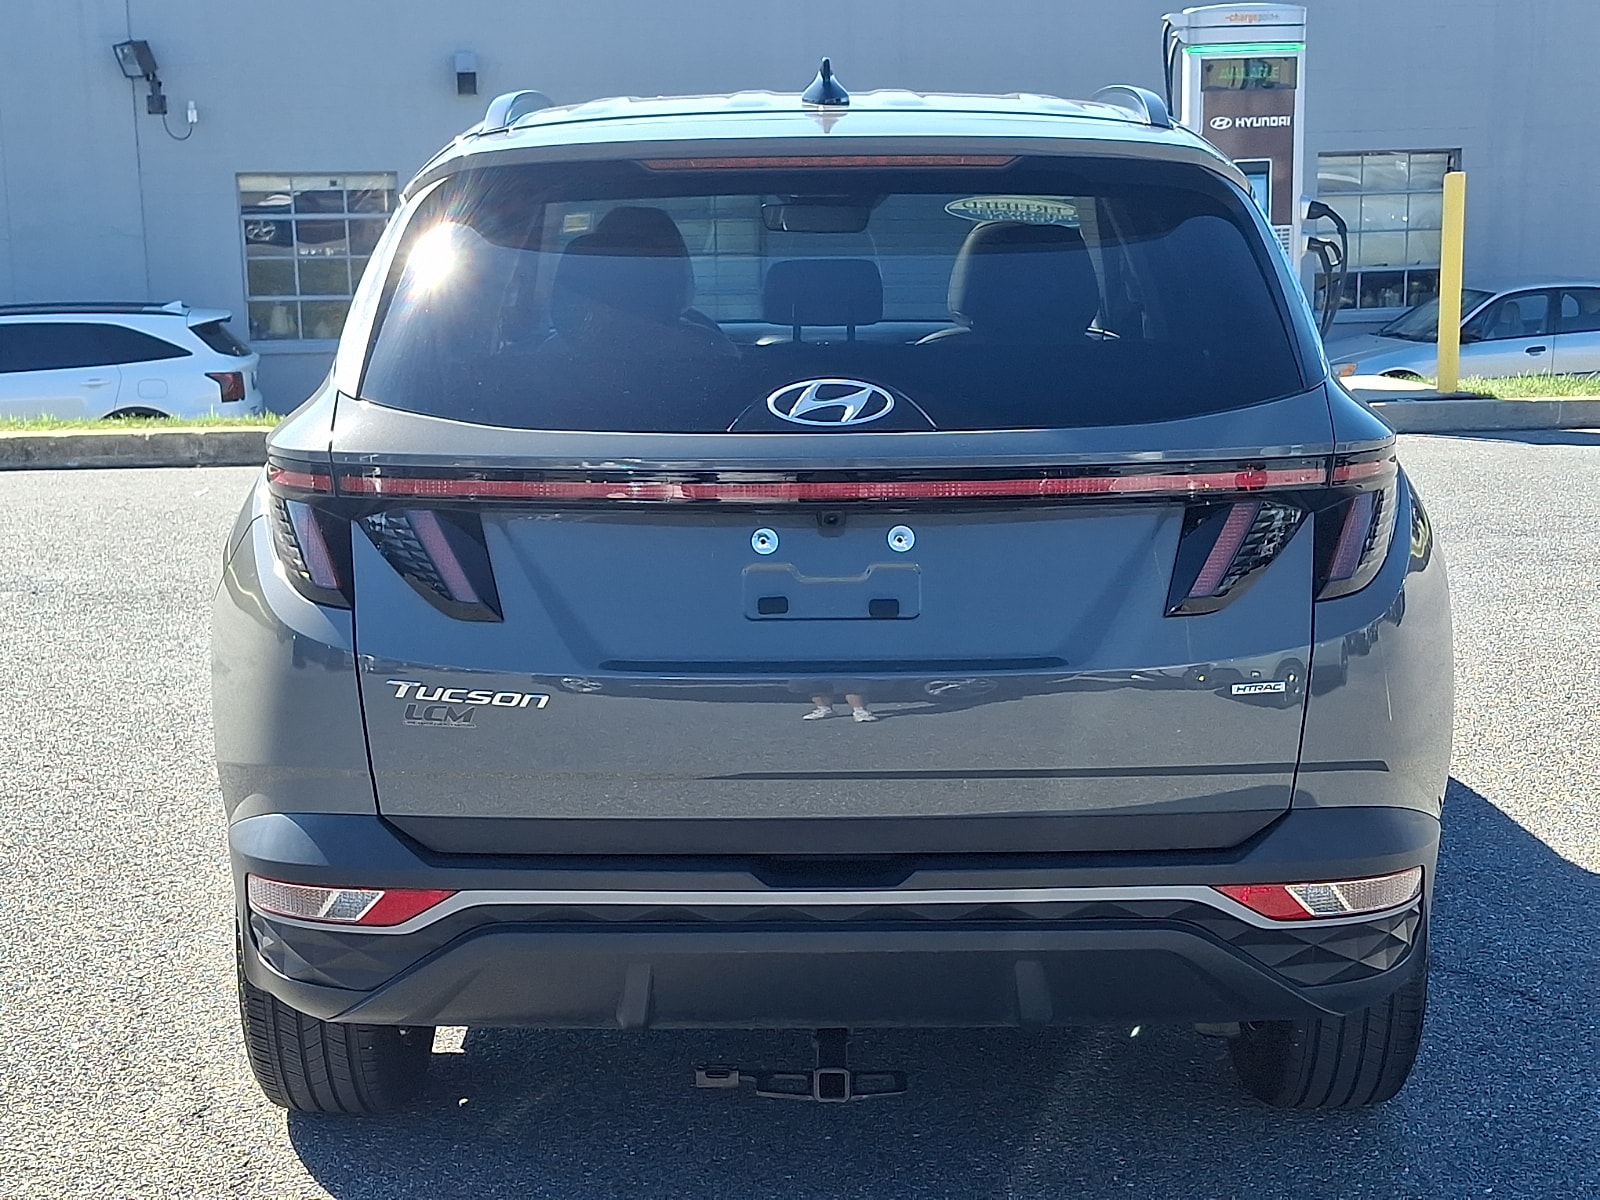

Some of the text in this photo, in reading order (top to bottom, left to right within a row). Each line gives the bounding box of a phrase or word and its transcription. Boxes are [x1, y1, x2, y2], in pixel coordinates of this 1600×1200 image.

[1235, 116, 1291, 127] HYUNDAI
[1236, 684, 1282, 692] HTRAC
[404, 703, 476, 723] LCM
